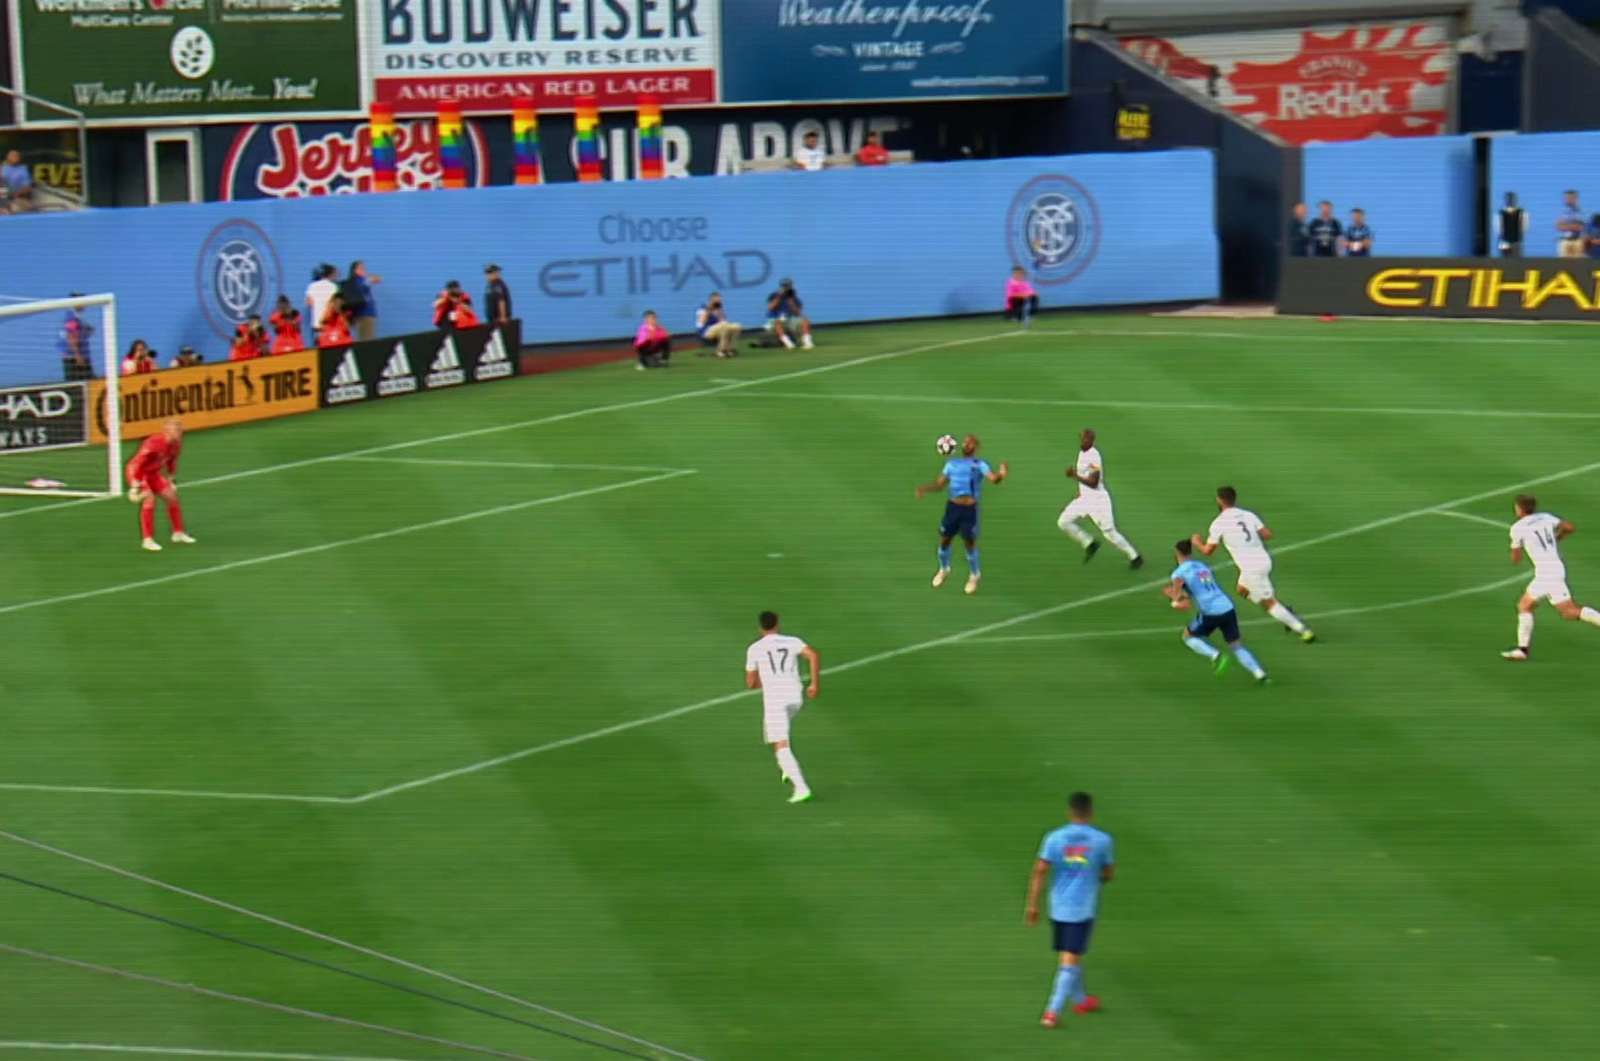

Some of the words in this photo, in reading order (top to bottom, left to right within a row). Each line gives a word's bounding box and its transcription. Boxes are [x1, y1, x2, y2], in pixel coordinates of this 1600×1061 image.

[382, 0, 702, 45] BUDWEISER
[385, 51, 550, 70] DISCOVERY
[564, 46, 700, 65] RESERVE
[399, 81, 535, 100] AMERICAN
[544, 79, 597, 96] RED
[606, 76, 691, 94] LAGER
[599, 212, 708, 244] Choose
[539, 249, 773, 297] ETIHAD
[1367, 267, 1600, 310] ETIHA
[260, 367, 312, 402] TIRE
[1237, 521, 1251, 543] 3
[1534, 527, 1554, 551] 14
[767, 648, 789, 675] 17
